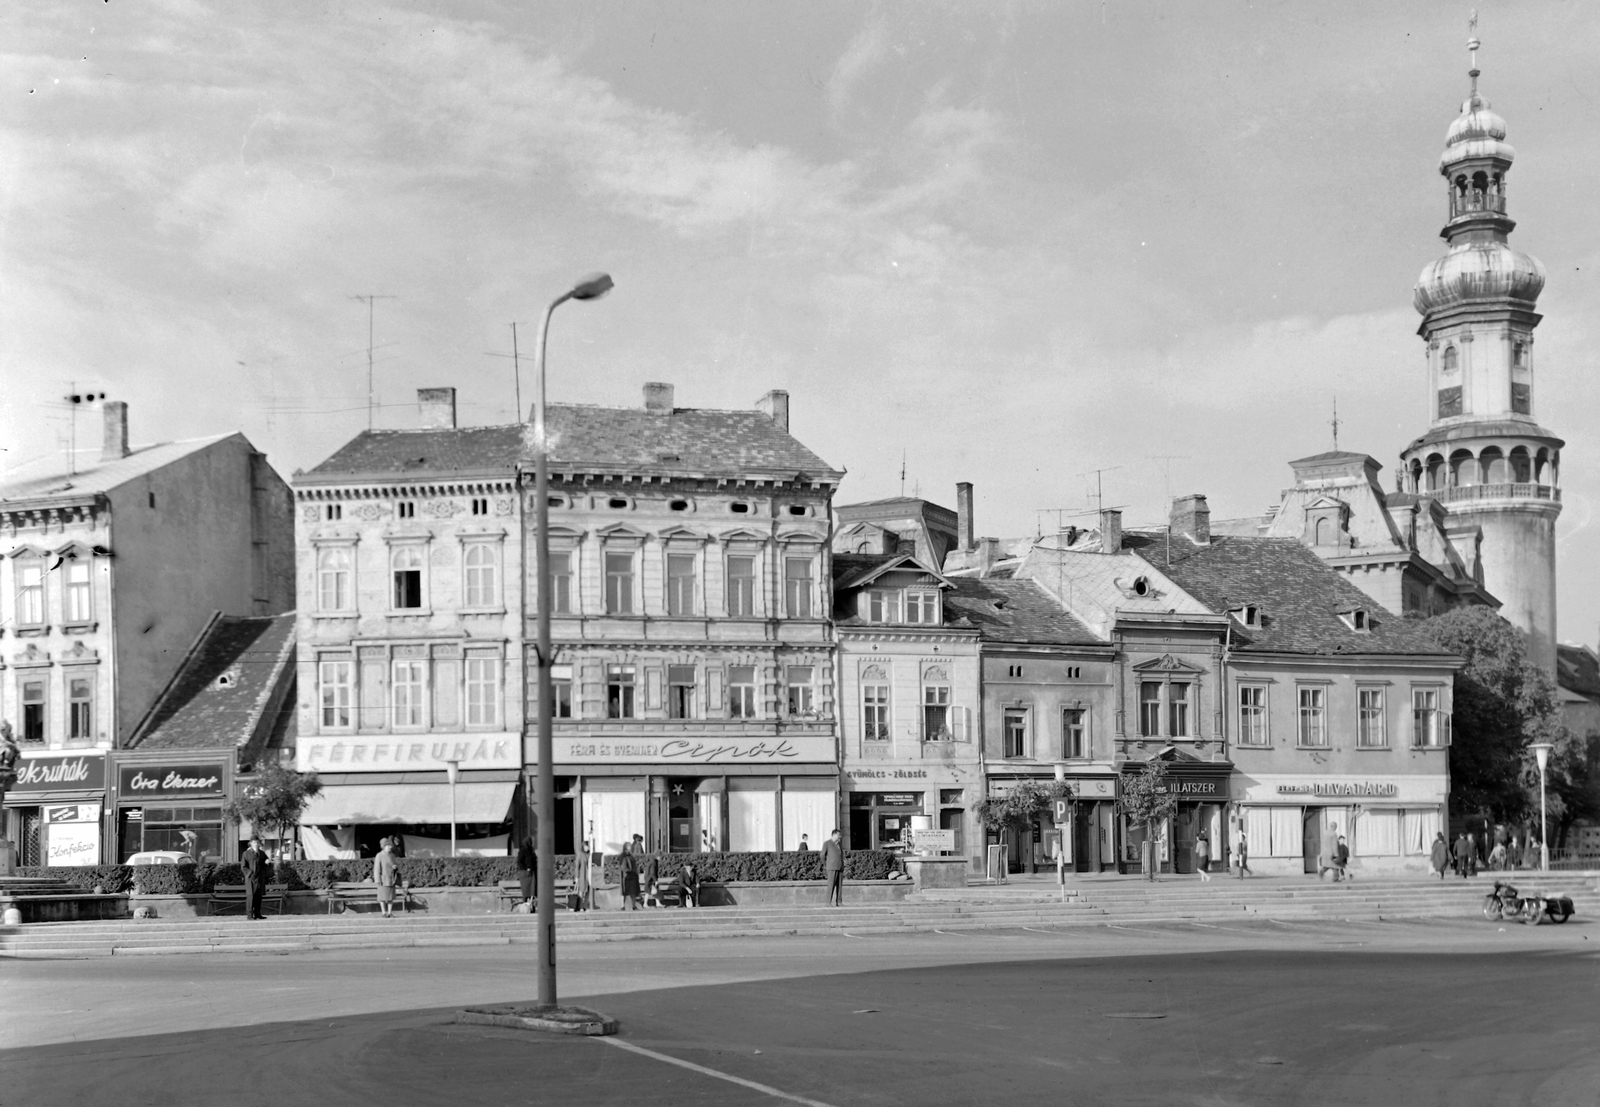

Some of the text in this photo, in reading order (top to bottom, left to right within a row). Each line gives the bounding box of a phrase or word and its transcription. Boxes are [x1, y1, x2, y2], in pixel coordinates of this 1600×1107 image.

[600, 743, 611, 756] ÉS
[14, 756, 90, 784] ekruhák
[894, 769, 928, 779] ZÖLDSÉG
[131, 770, 219, 790] Óra Ékszer
[1170, 782, 1217, 793] ILLATSZER
[1313, 782, 1395, 794] DIVATÁRU
[1057, 801, 1066, 819] P
